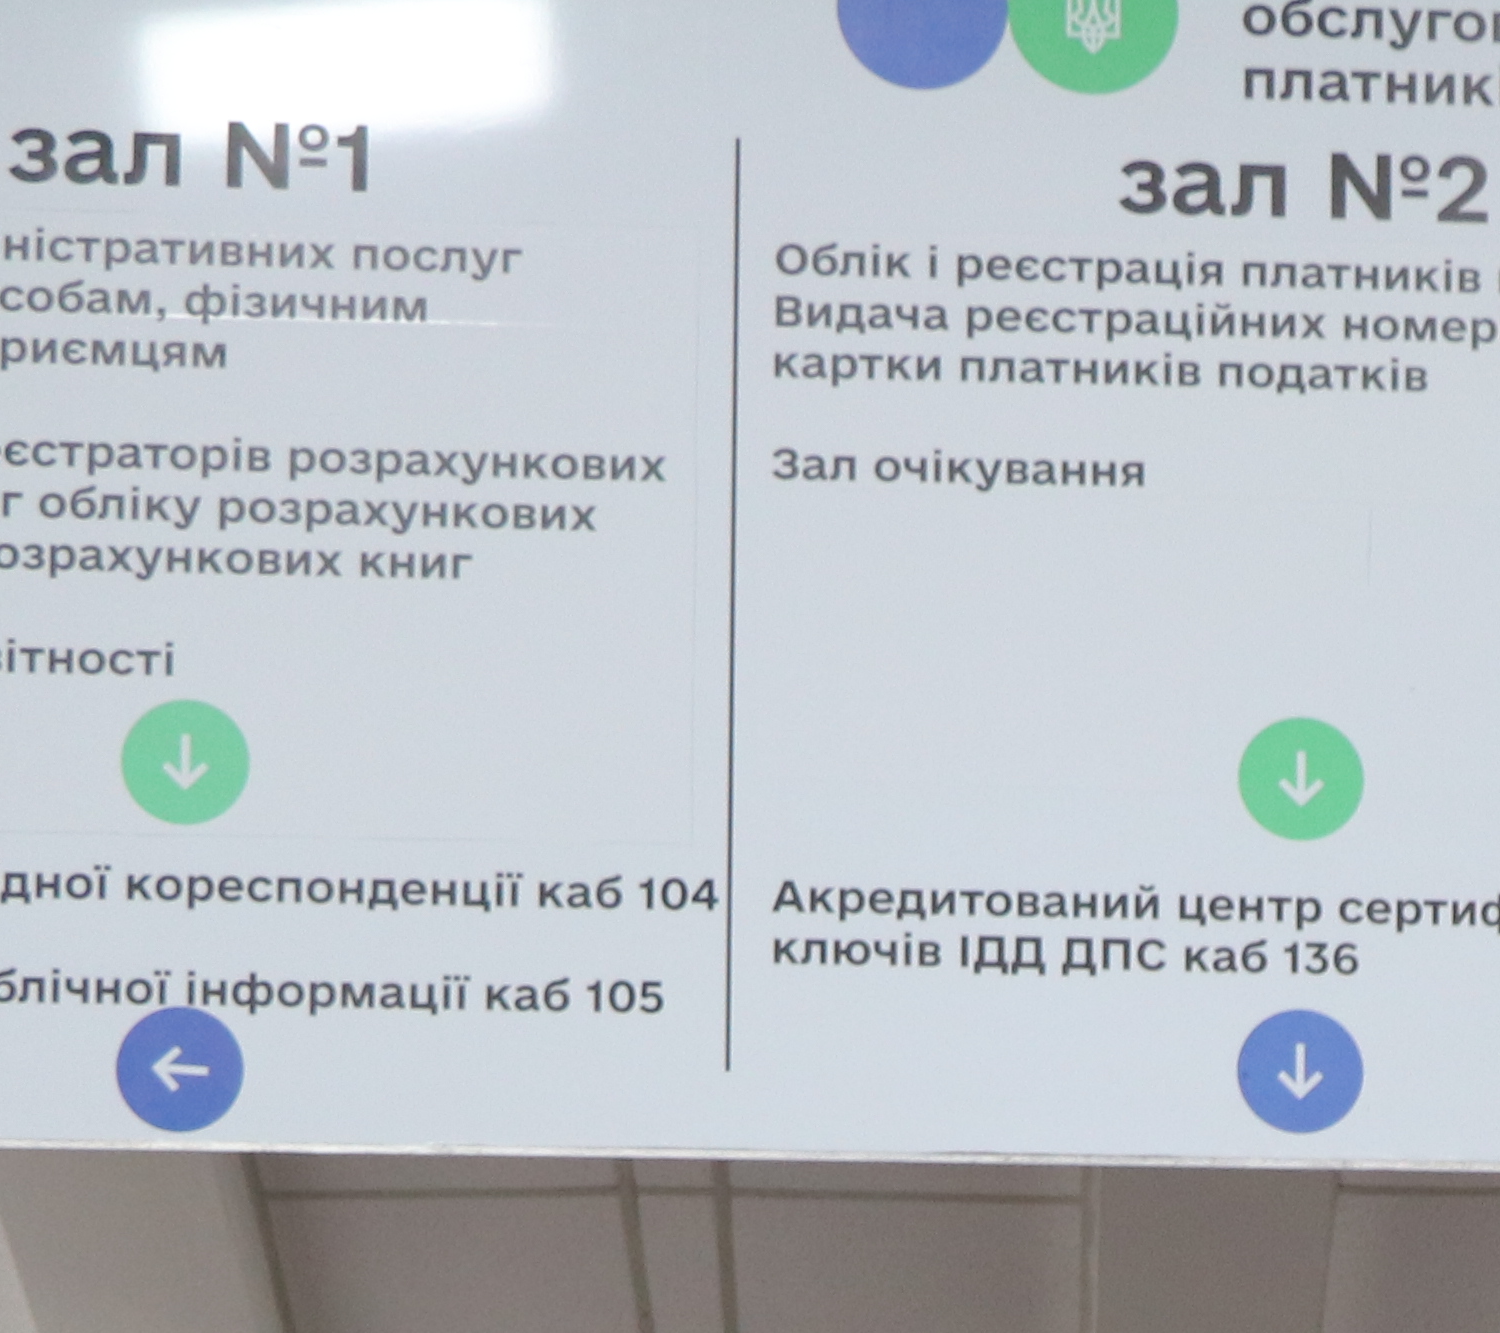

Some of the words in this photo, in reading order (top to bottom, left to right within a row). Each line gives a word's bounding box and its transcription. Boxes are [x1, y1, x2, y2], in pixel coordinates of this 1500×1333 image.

[8, 127, 181, 187] зал
[226, 121, 368, 192] №1
[1119, 159, 1286, 218] зал
[1330, 152, 1488, 224] №2
[353, 245, 522, 281] послуг
[776, 242, 911, 278] Облік
[929, 245, 937, 279] і
[957, 251, 1223, 291] реєстрація
[1242, 259, 1481, 293] платників
[185, 283, 427, 325] фізичним
[775, 295, 949, 334] Видача
[967, 302, 1325, 343] реєстраційних
[774, 352, 941, 388] картки
[960, 352, 1201, 387] платників
[1218, 357, 1427, 395] податків
[289, 447, 665, 486] розрахункових
[772, 447, 856, 481] Зал
[874, 449, 1145, 493] очікування
[39, 485, 201, 530] обліку
[219, 496, 595, 535] розрахункових
[360, 551, 473, 579] книг
[126, 872, 524, 913] кореспонденції
[538, 874, 623, 910] каб
[639, 877, 719, 912] 104
[772, 880, 1159, 922] Акредитований
[1178, 894, 1322, 932] центр
[773, 931, 941, 967] ключів
[960, 935, 1046, 976] ІДД
[1061, 936, 1166, 977] ДПС
[1184, 938, 1268, 974] каб
[1284, 941, 1359, 976] 136
[187, 970, 471, 1016] інформації
[486, 977, 570, 1012] каб
[587, 979, 664, 1014] 105
